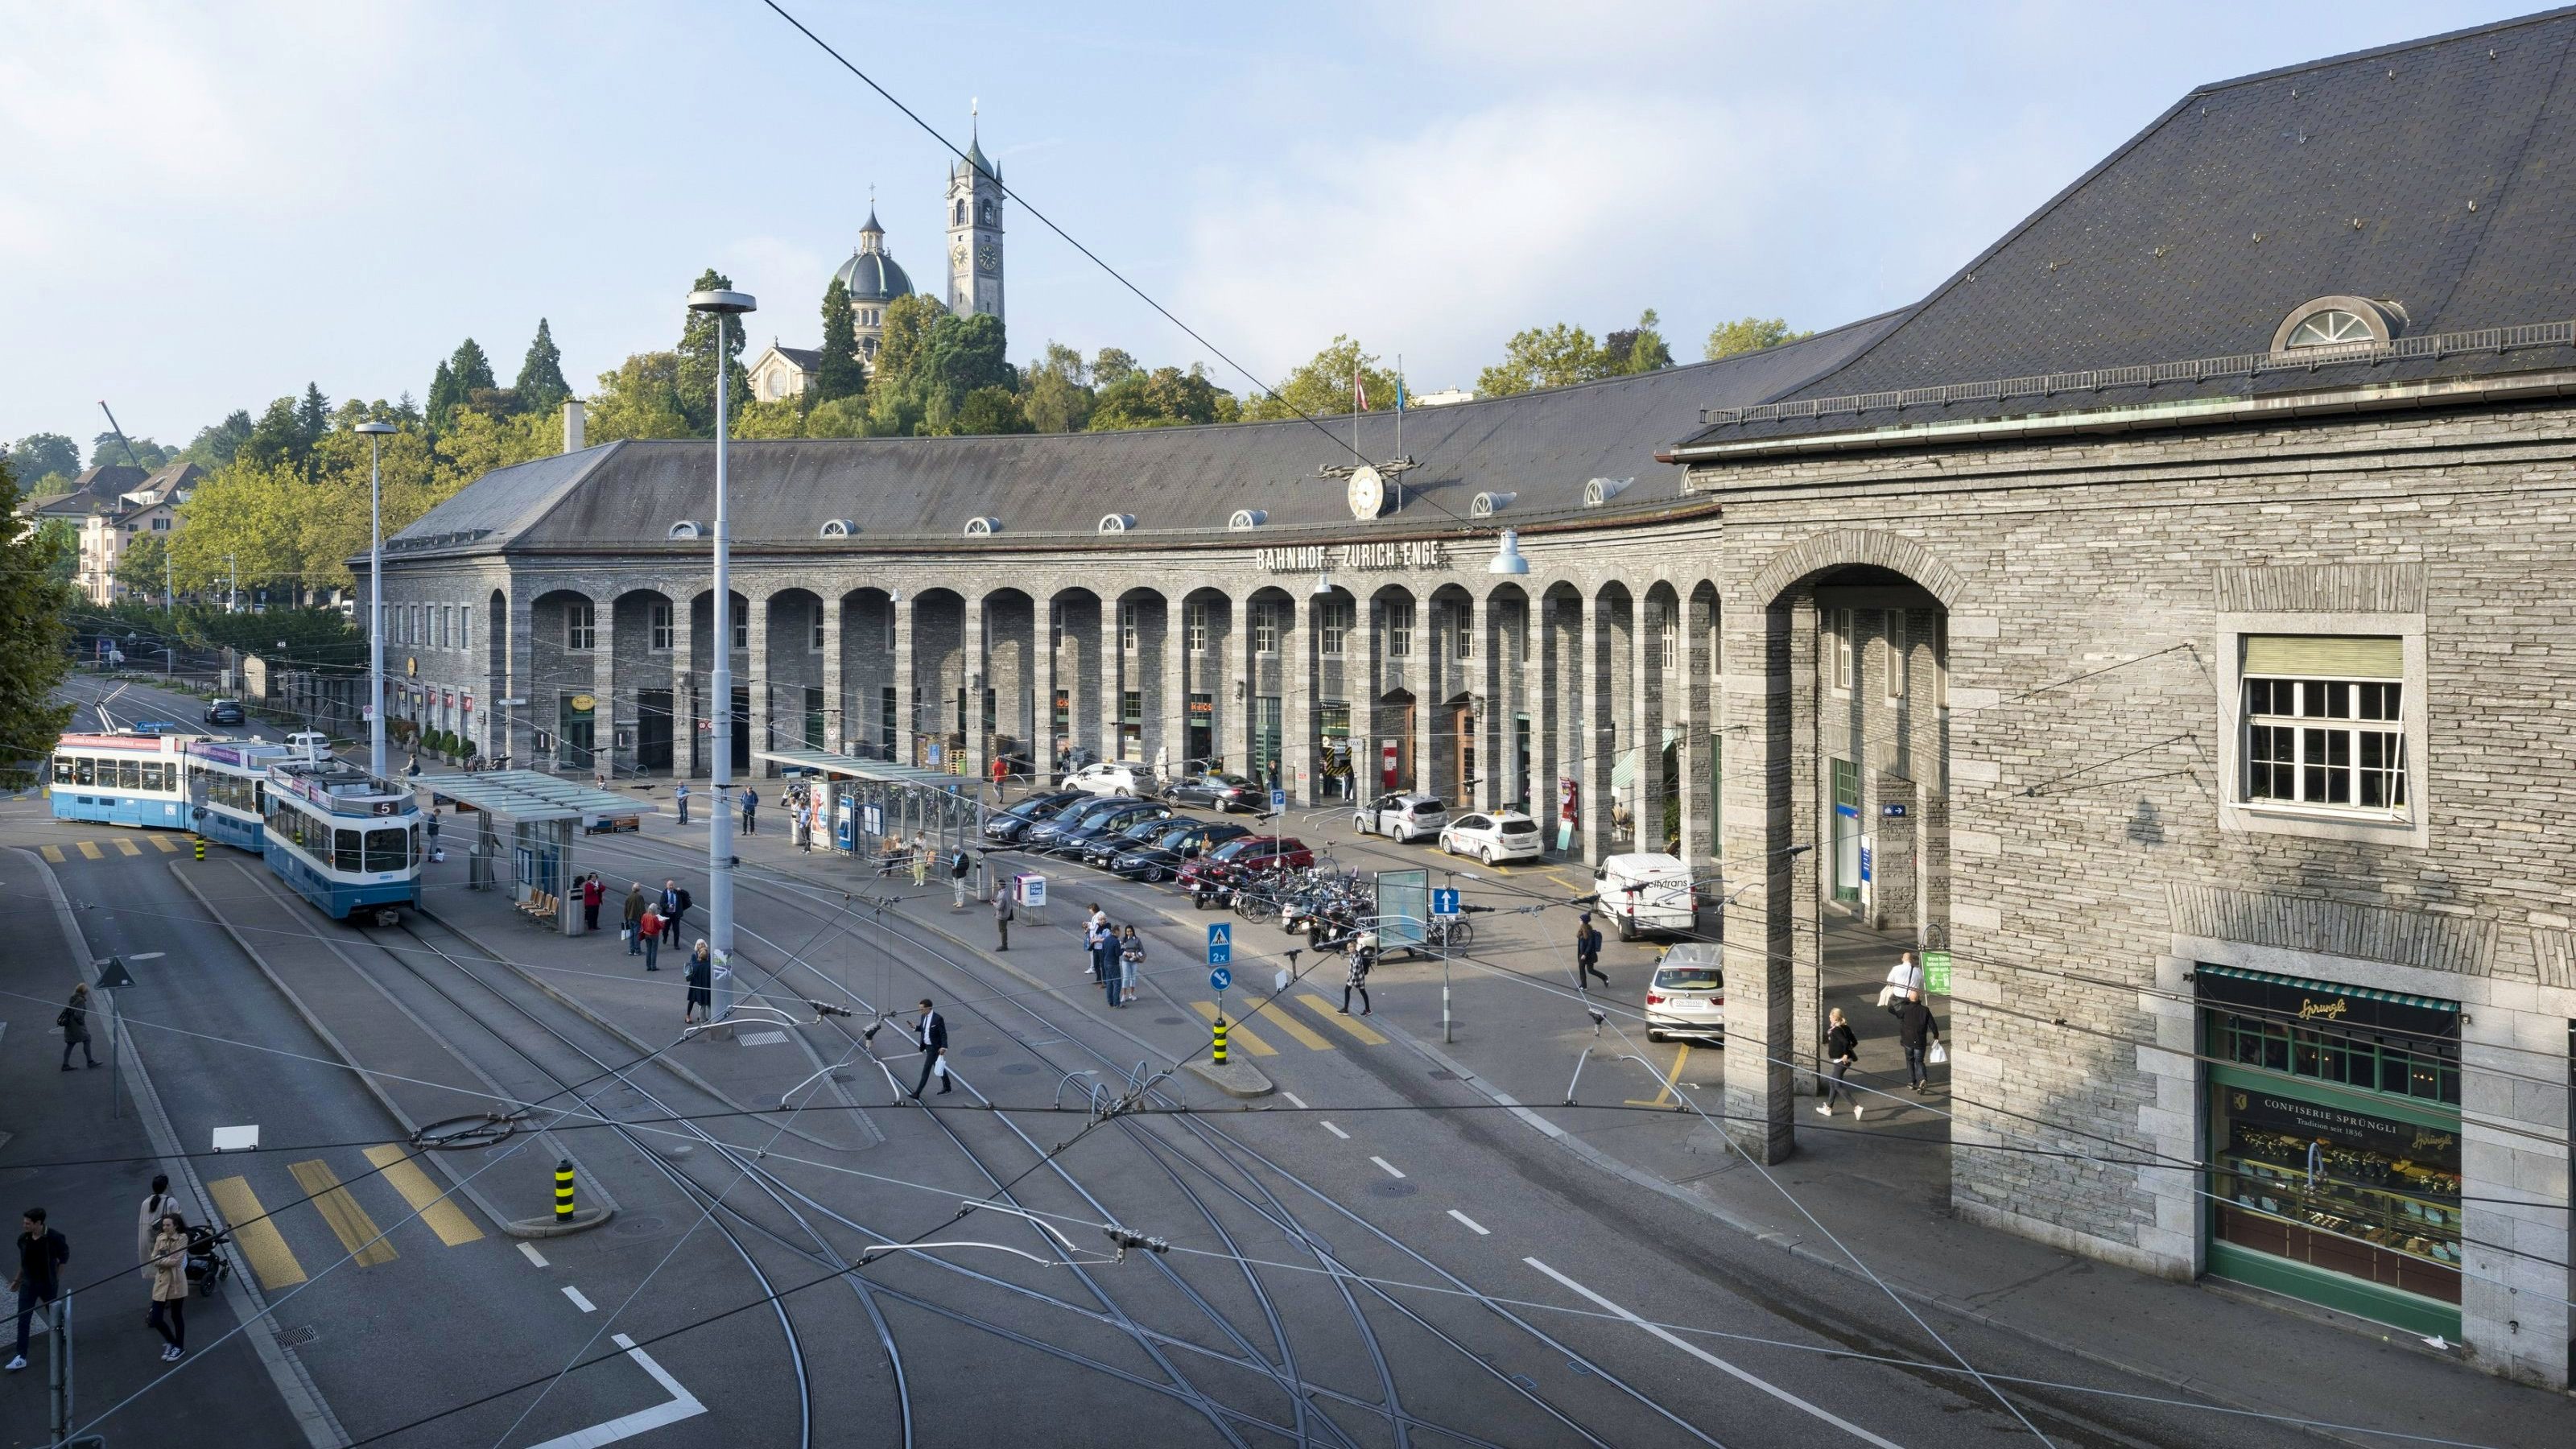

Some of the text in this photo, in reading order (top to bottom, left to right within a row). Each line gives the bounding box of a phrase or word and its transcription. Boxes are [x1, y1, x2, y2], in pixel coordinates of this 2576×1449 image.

[1257, 547, 1325, 570] BAHNHOF
[1403, 540, 1439, 566] ENGE
[1275, 793, 1282, 803] P
[381, 803, 390, 814] 5
[1648, 879, 1688, 889] citytrans
[2264, 1099, 2397, 1134] CONFISERIE SPRÜNGLI
[2296, 1117, 2363, 1138] Tradition seit 1836
